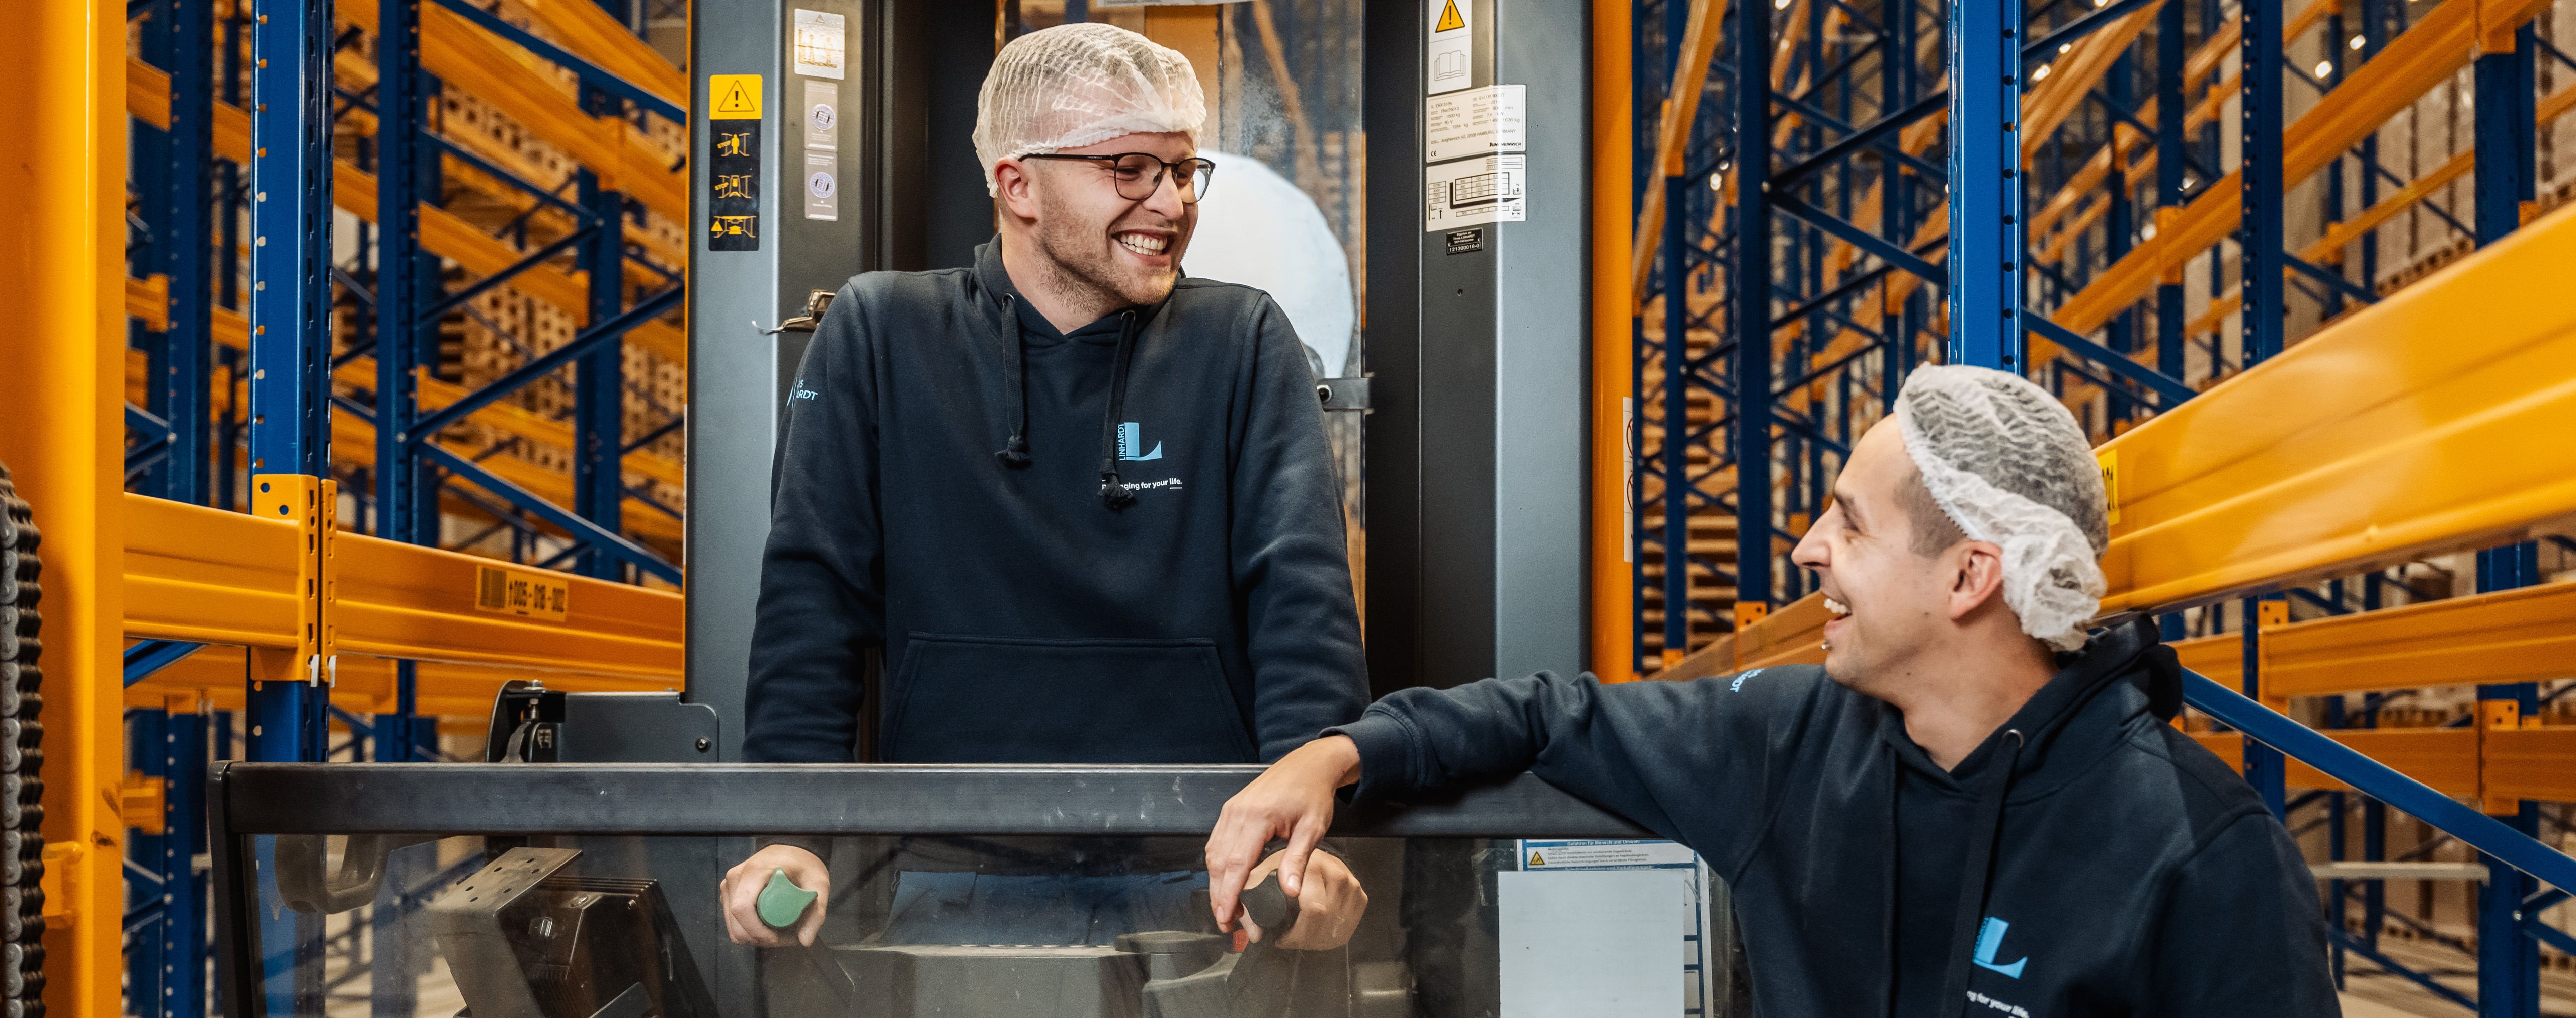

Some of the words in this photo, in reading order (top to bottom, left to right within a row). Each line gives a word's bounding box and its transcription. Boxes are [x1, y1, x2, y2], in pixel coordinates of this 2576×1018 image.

[1449, 243, 1479, 252] 121300016-0
[1118, 424, 1126, 461] LINHARDT
[1151, 479, 1168, 489] your
[1988, 999, 2013, 1013] your
